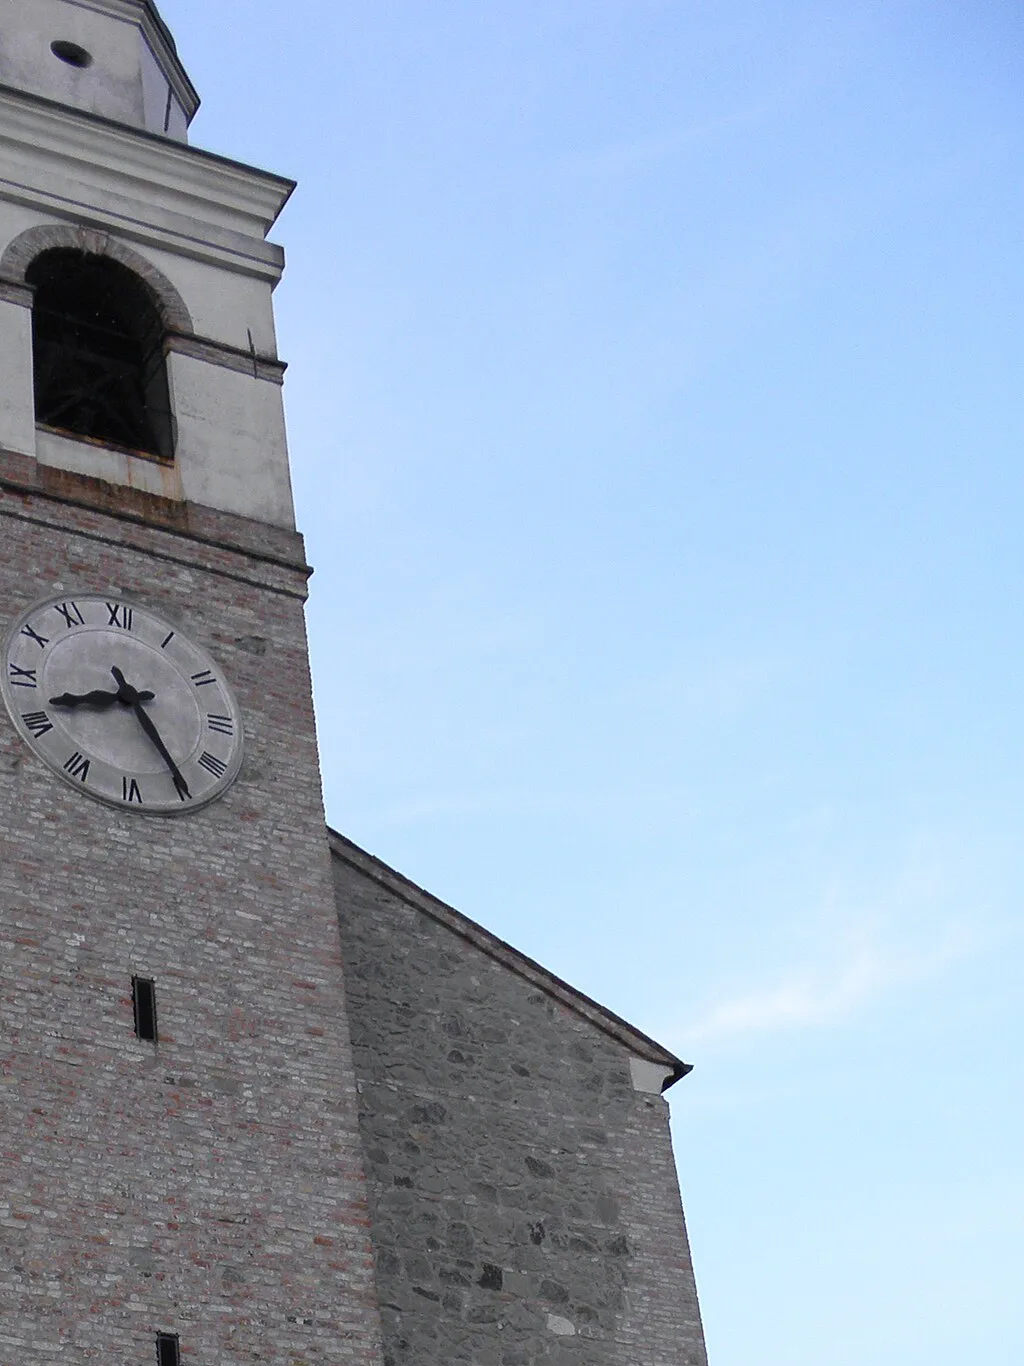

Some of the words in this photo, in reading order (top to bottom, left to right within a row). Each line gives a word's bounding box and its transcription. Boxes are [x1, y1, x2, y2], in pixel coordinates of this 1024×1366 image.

[54, 601, 85, 628] XI
[106, 602, 133, 631] XII
[20, 623, 49, 649] X
[160, 631, 175, 649] I
[9, 663, 37, 688] IX
[190, 670, 217, 686] II
[21, 710, 54, 739] VIII
[207, 713, 234, 736] III
[63, 751, 91, 782] VII
[123, 776, 143, 804] VI
